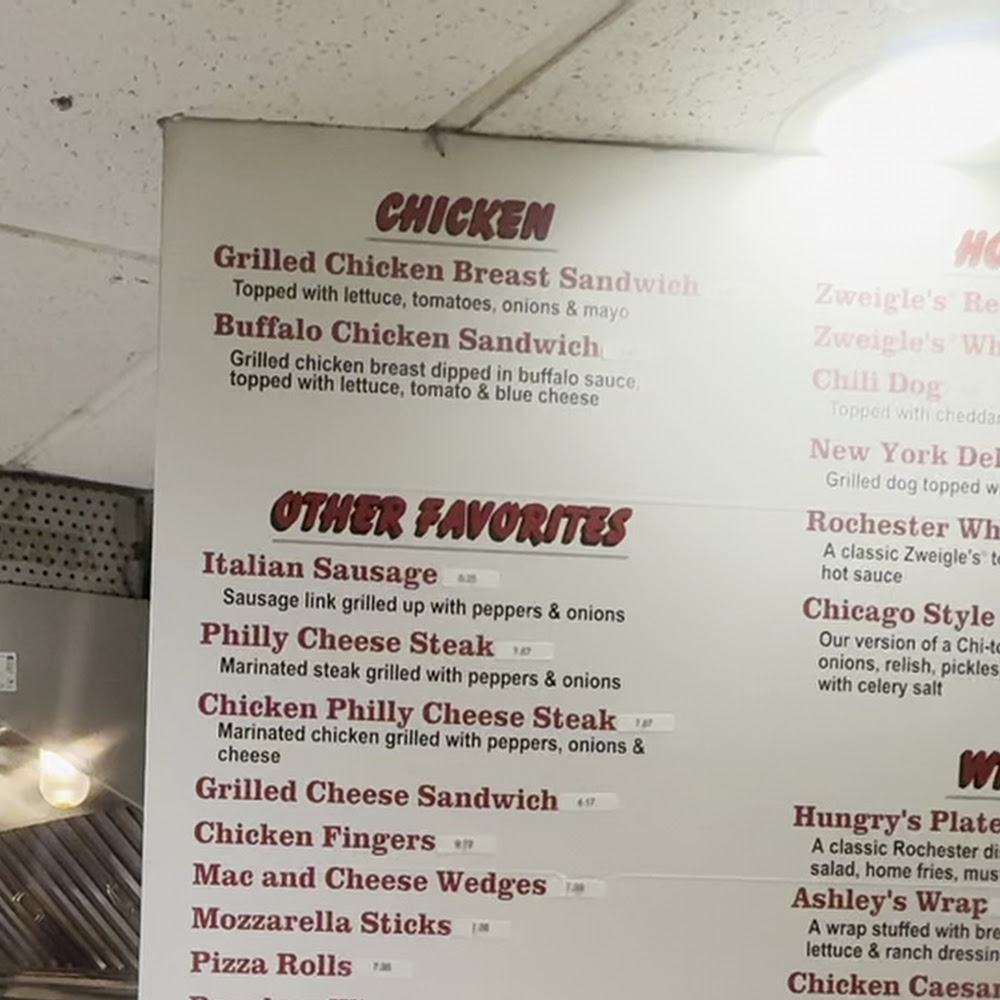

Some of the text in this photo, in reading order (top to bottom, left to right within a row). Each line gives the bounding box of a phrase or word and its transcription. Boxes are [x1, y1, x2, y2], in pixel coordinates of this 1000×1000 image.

[375, 191, 556, 242] CHICKEN
[213, 244, 699, 297] Grilled Chicken Breast Sandwich
[232, 278, 629, 323] Topped with lettuce, tomatoes, onions mayo
[814, 282, 947, 315] Zweigle's
[213, 312, 599, 358] Buffalo Chicken Sandwich
[813, 324, 945, 358] Zweigle's
[230, 349, 290, 370] Grilled
[294, 353, 364, 374] chicken
[370, 357, 426, 378] breast
[430, 361, 492, 384] dipped
[518, 366, 579, 387] buffalo
[229, 370, 600, 407] topped with lettuce, tomato blue cheese
[812, 368, 943, 403] Chili Dog
[810, 438, 948, 466] New York
[825, 471, 881, 490] Grilled
[886, 475, 918, 496] dog
[921, 477, 981, 497] topped
[269, 489, 633, 548] OTHER FAVORITES
[806, 510, 950, 538] Rochester
[202, 551, 438, 591] Italian Sausage
[841, 543, 981, 568] classic Zweigle's
[853, 569, 903, 584] sauce
[223, 587, 626, 623] Sausage link grilled with peppers onions
[802, 596, 995, 632] Chicago Style
[199, 622, 495, 657] Philly Cheese Steak
[854, 634, 916, 651] version
[220, 656, 622, 690] Marinated steak grilled with peppers onions
[818, 656, 880, 673] onions,
[885, 656, 936, 675] relish,
[818, 676, 943, 699] with celery salt
[198, 692, 617, 731] Chicken Philly Cheese Steak
[217, 745, 281, 764] cheese
[218, 721, 627, 755] Marinated chicken grilled with peppers, onions
[195, 776, 558, 811] Grilled Cheese Sandwich
[793, 805, 922, 837] Hungry's
[194, 820, 436, 857] Chicken Fingers
[829, 838, 888, 857] classic
[893, 839, 979, 859] Rochester
[192, 862, 254, 887] Mac
[261, 866, 316, 889] and
[324, 866, 429, 892] Cheese
[435, 870, 547, 901] Wedges
[810, 859, 958, 882] salad, home fries,
[791, 886, 988, 921] Ashley's Wrap
[191, 906, 353, 934] Mozzarella
[360, 911, 452, 936] Sticks
[825, 920, 970, 940] wrap stuffed with
[190, 950, 269, 975] Pizza
[276, 952, 352, 977] Rolls
[806, 940, 933, 961] lettuce ranch
[787, 971, 901, 997] Chicken
